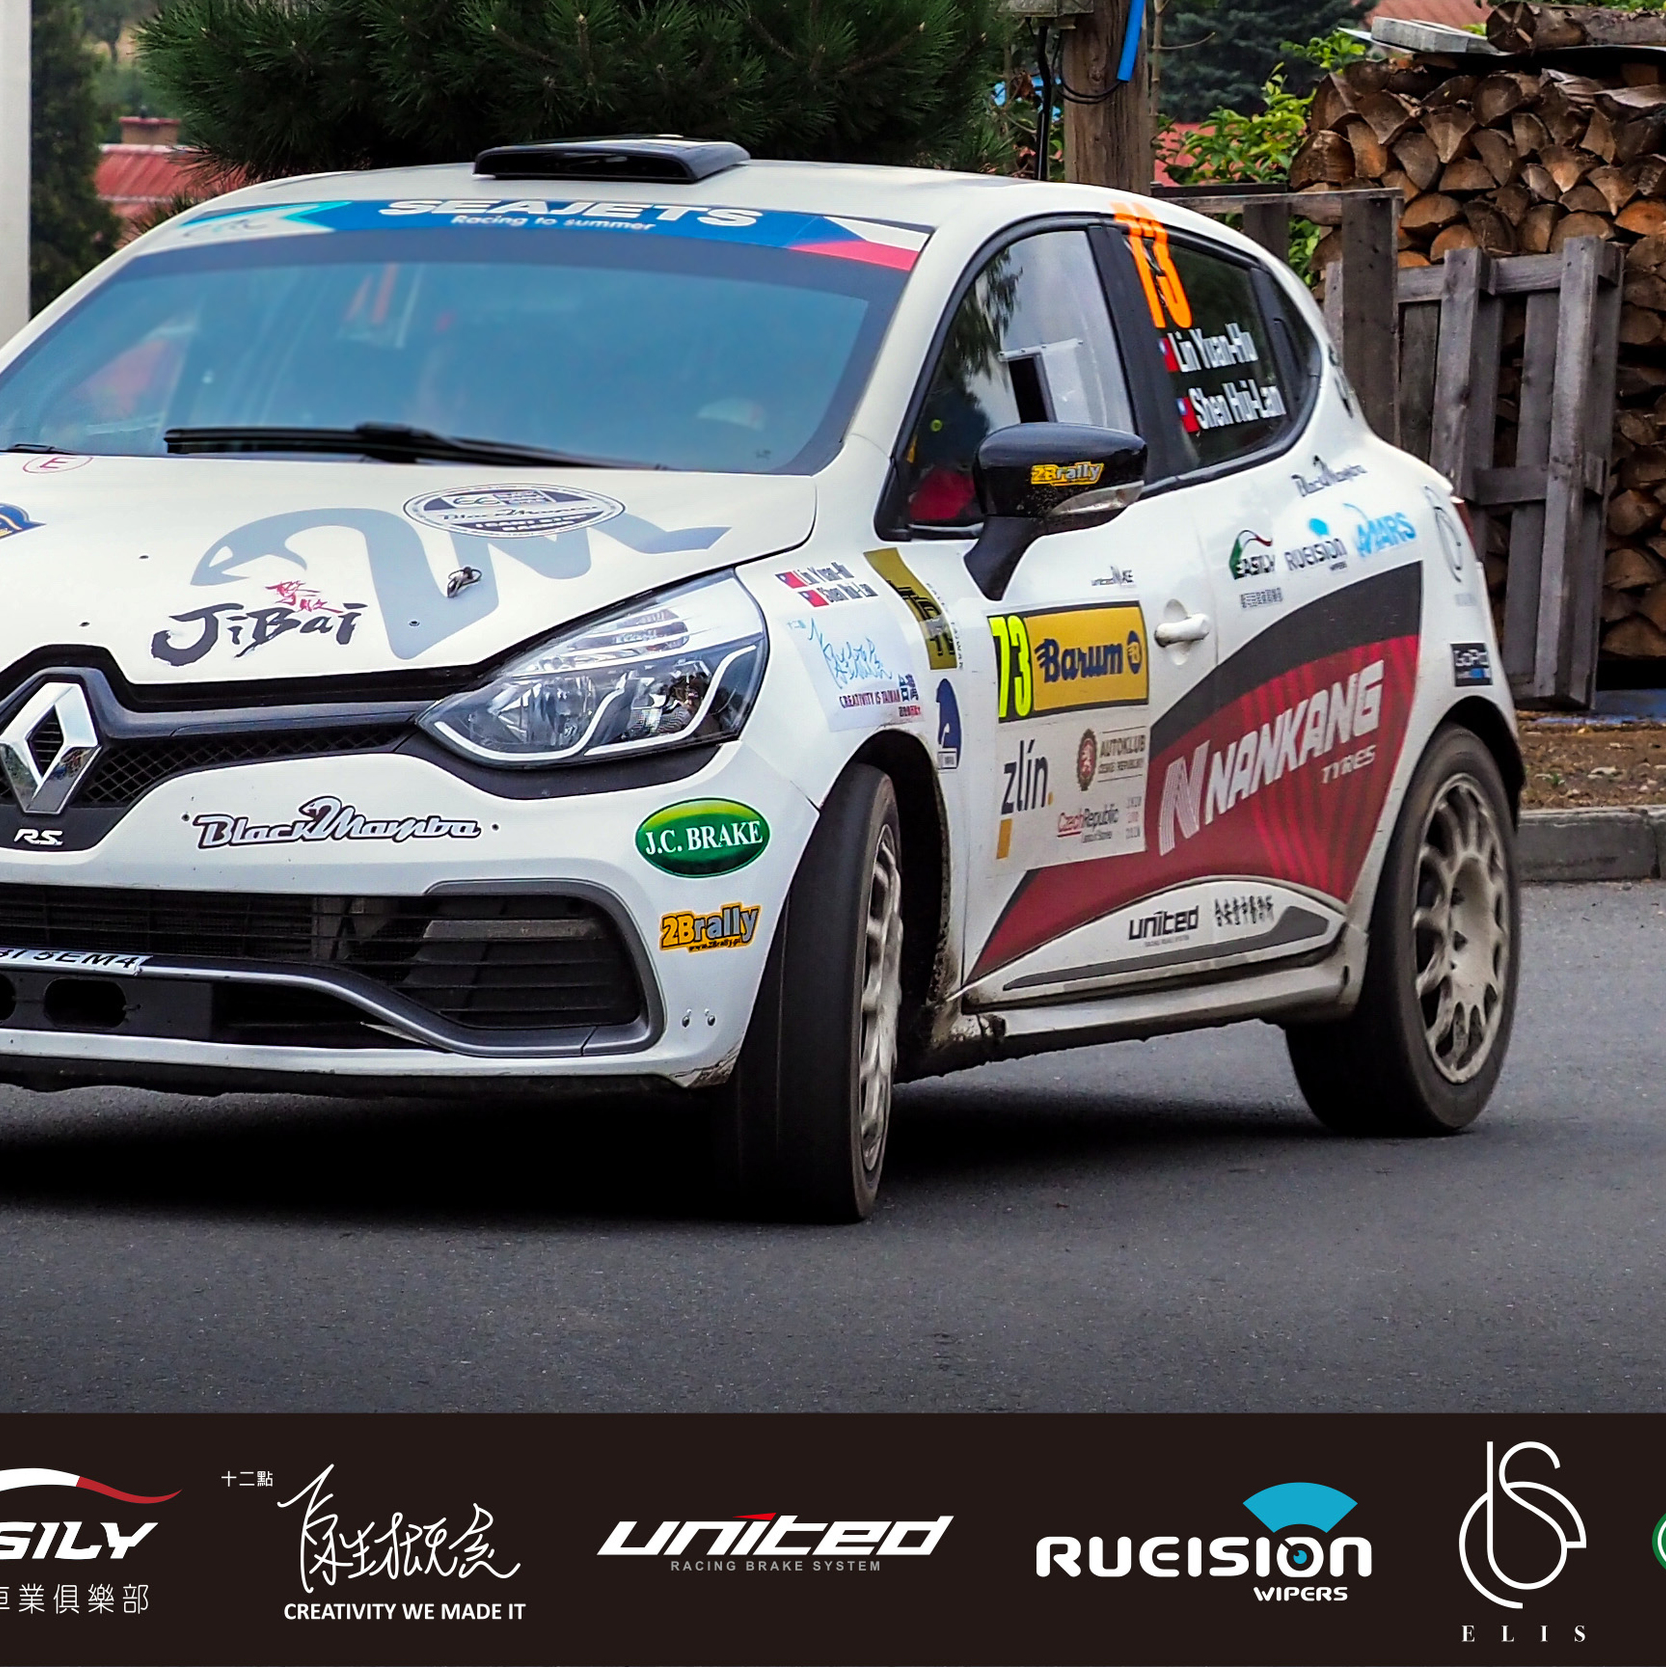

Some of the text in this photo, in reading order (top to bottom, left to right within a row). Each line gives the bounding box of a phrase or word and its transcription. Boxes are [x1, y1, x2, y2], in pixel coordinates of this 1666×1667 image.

[378, 199, 764, 227] SEAJETS
[450, 214, 656, 231] Racing to summer
[151, 602, 368, 666] JiBai
[988, 614, 1124, 718] 73 Barum
[1205, 660, 1384, 825] NANKANG
[13, 829, 64, 847] RS
[645, 820, 763, 854] J.C. BRAKE
[661, 905, 759, 949] 2Brally
[1129, 905, 1199, 940] united
